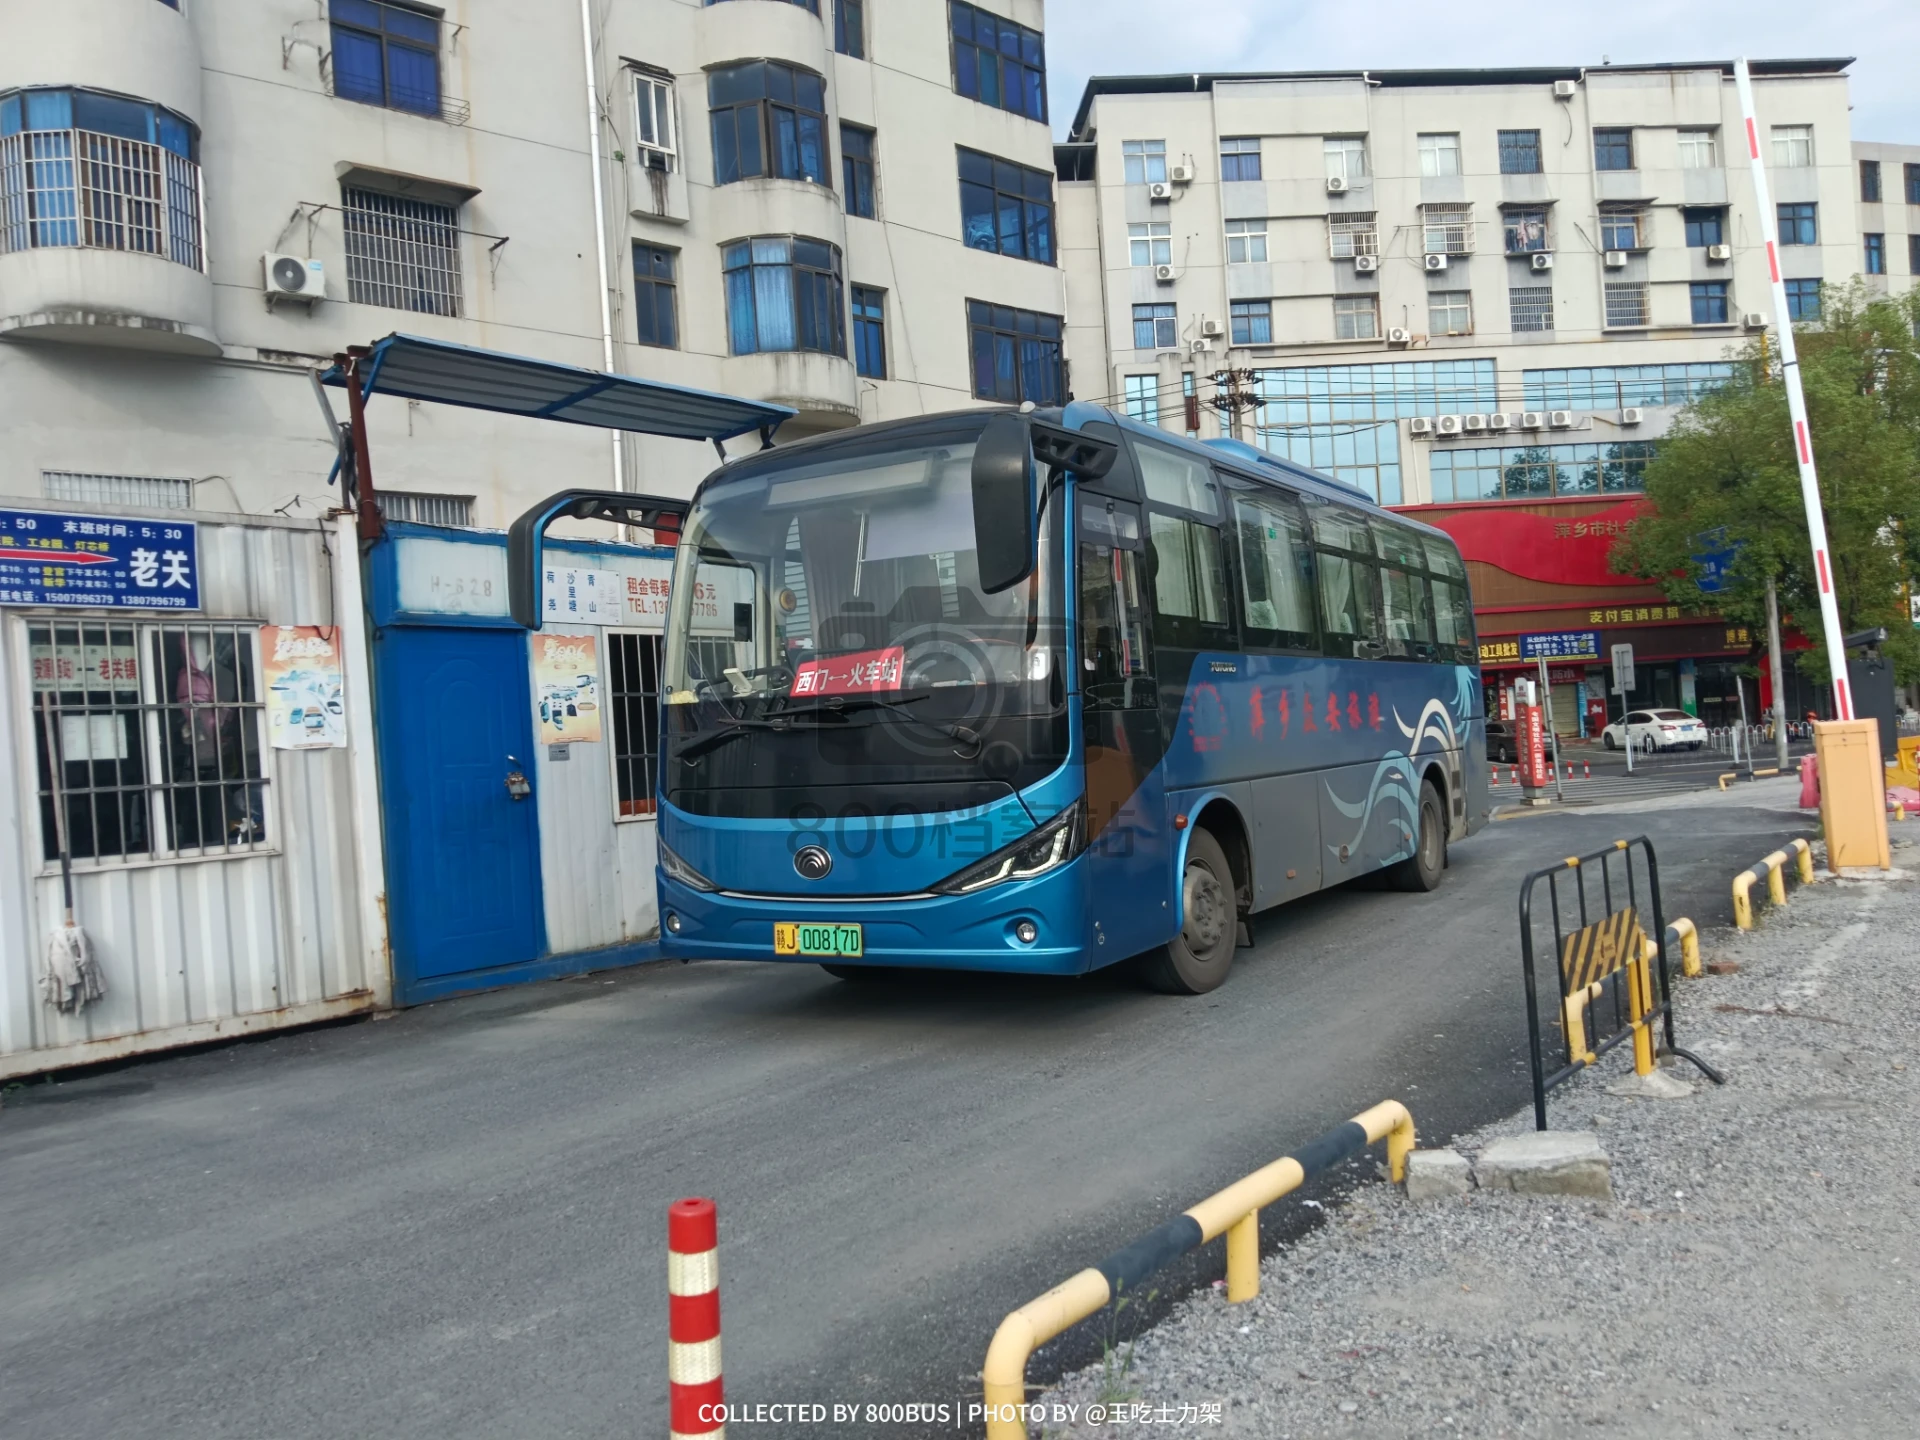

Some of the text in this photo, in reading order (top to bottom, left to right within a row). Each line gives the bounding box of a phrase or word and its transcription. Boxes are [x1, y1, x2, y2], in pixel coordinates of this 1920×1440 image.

[130, 548, 191, 589] 老关
[121, 595, 186, 607] 13807996799
[795, 657, 898, 694] 西门 火车站
